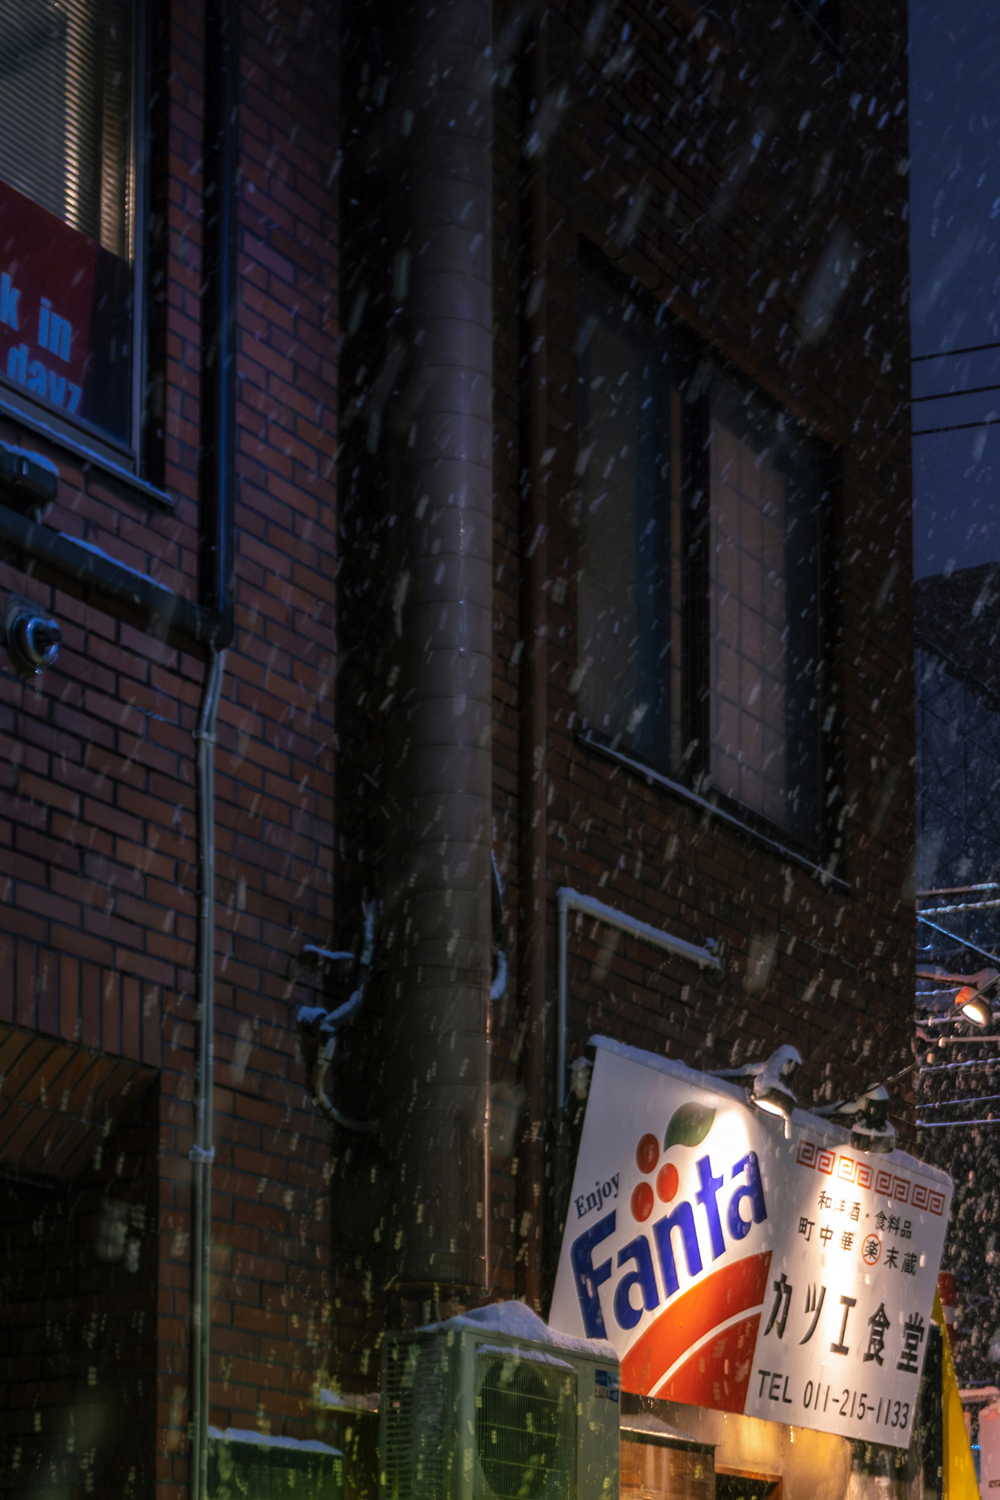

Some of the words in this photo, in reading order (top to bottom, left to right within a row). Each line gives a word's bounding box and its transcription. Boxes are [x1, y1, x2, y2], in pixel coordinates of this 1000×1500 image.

[37, 297, 72, 362] in
[574, 1172, 620, 1219] Enjoy
[817, 1191, 913, 1240] 和洋酒・食料品
[570, 1151, 768, 1339] Fanta
[757, 1370, 792, 1404] TEL
[803, 1380, 910, 1430] 011-215-1133
